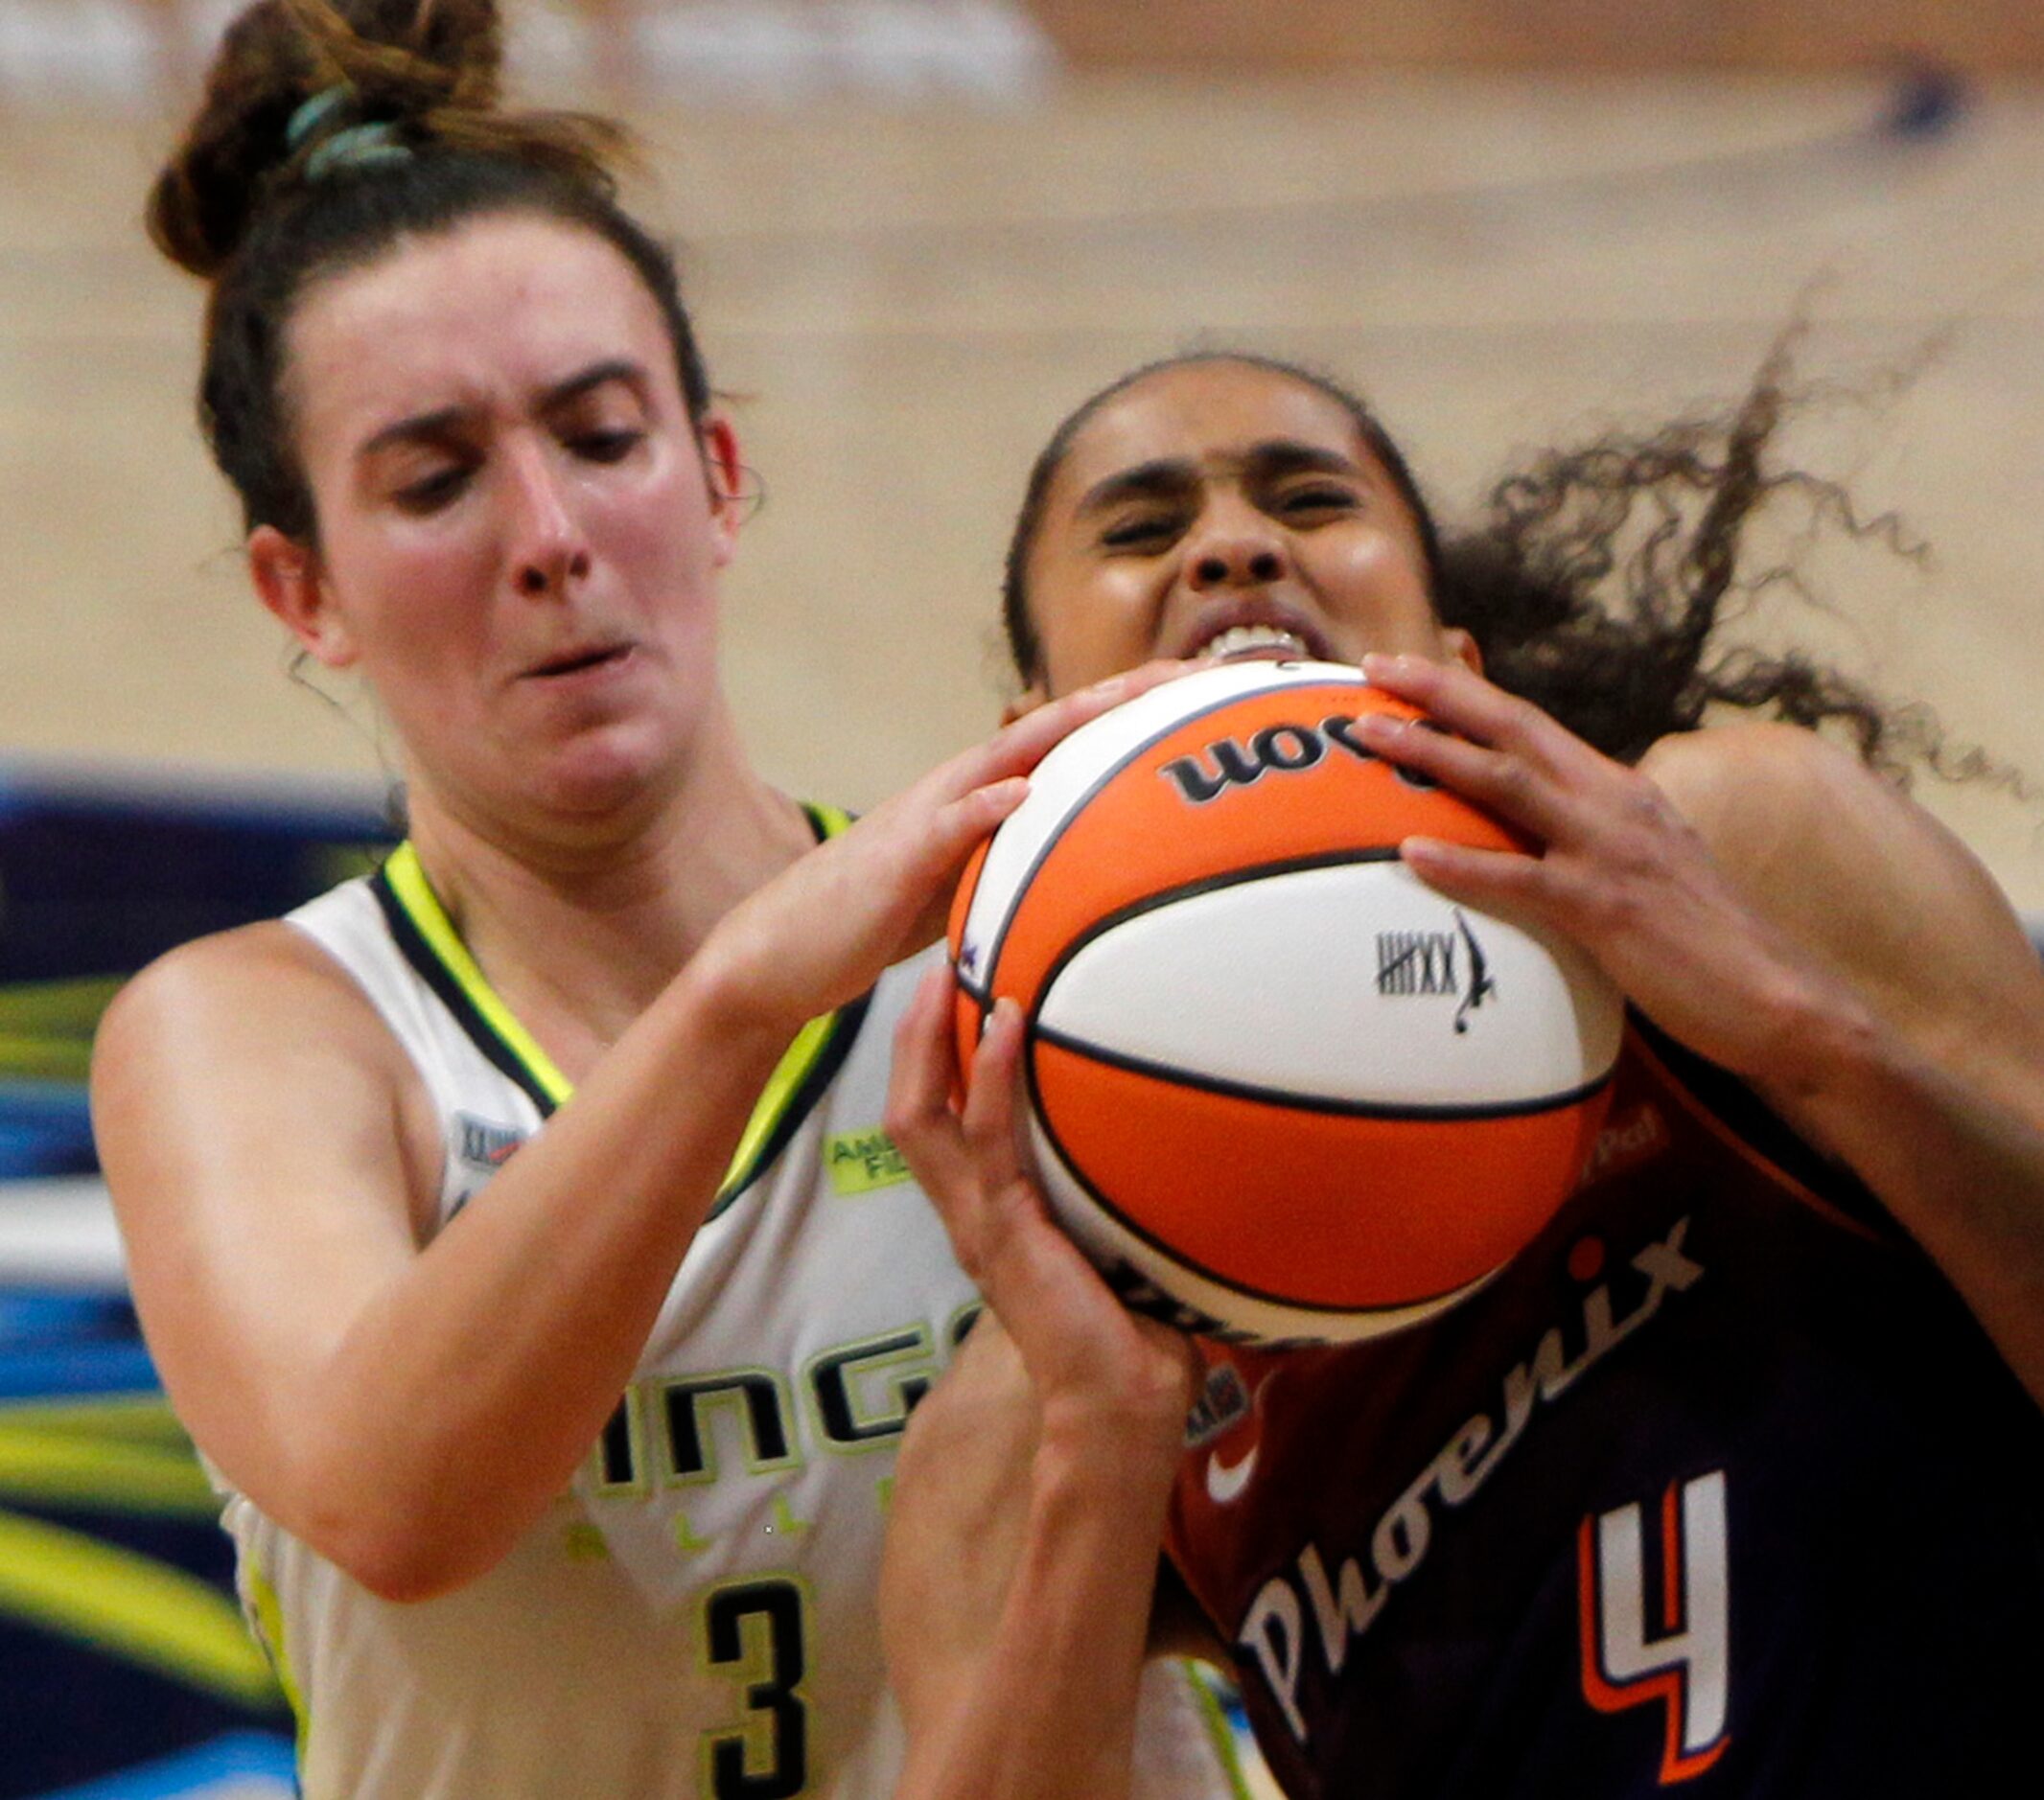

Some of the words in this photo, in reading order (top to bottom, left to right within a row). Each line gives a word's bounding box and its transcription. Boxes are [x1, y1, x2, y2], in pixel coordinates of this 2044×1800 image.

[1239, 1215, 1706, 1742] Phoenix
[1577, 1468, 1731, 1787] 4
[697, 1569, 817, 1800] 3
